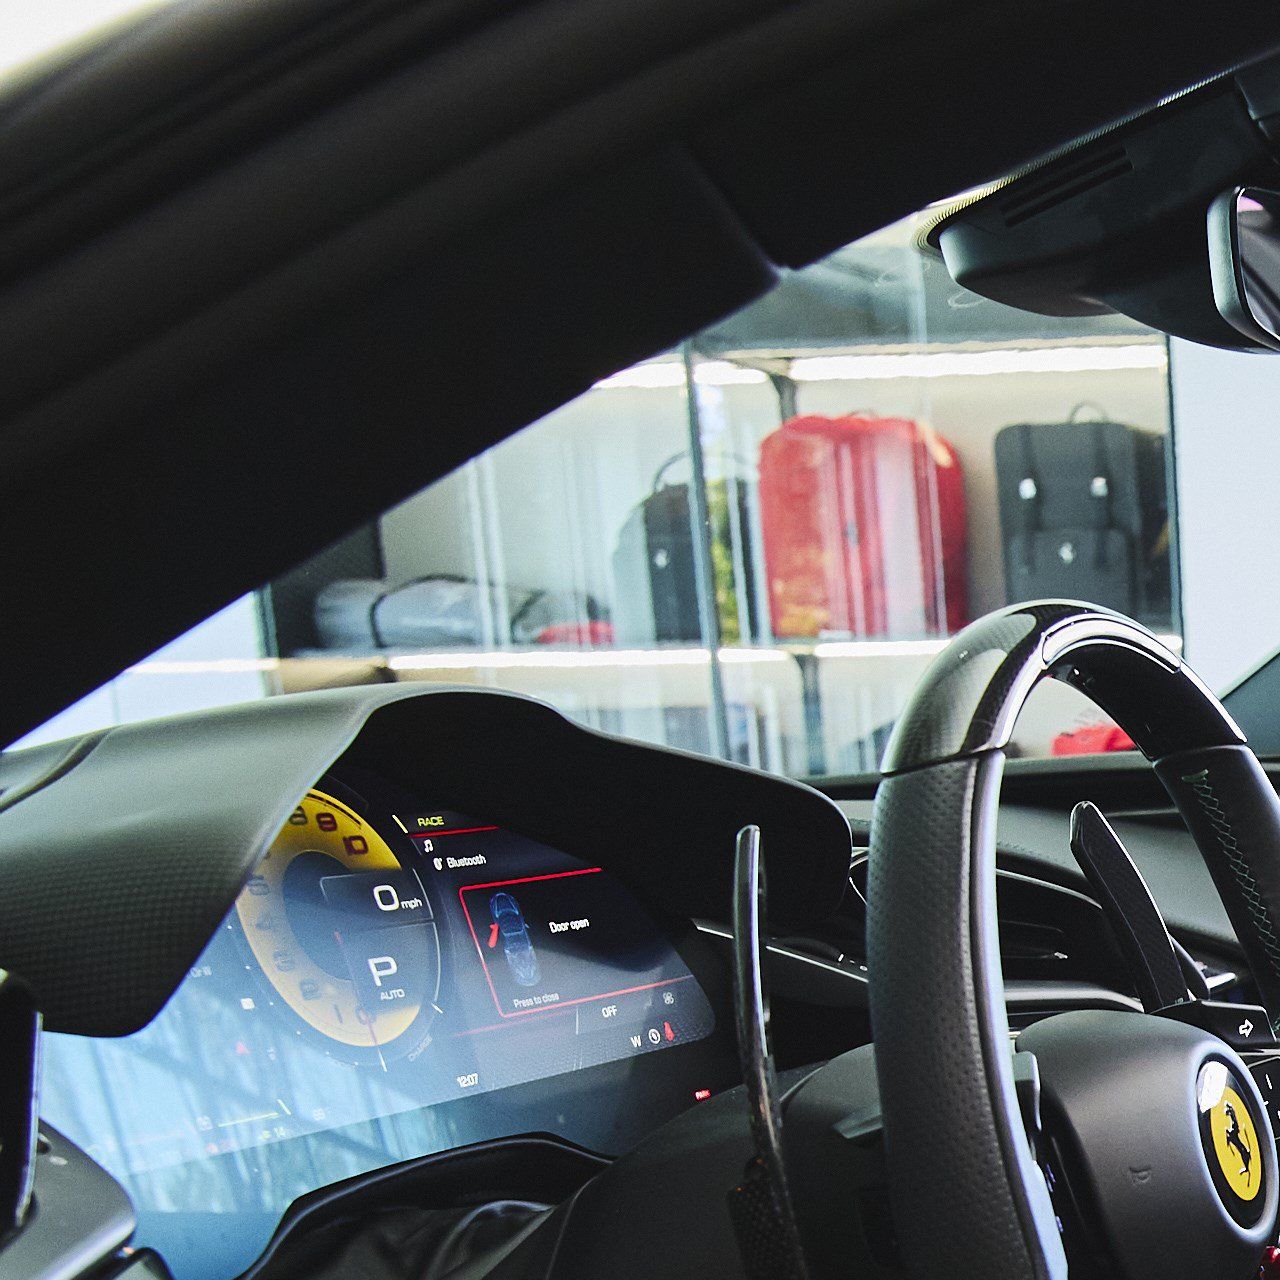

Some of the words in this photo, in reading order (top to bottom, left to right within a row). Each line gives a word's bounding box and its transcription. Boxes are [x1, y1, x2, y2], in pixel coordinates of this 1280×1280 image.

[316, 812, 338, 832] 9
[417, 816, 445, 827] RACE
[343, 835, 369, 856] 10
[447, 854, 487, 869] Bluetooth
[373, 885, 399, 911] 0
[401, 896, 423, 910] mph
[549, 920, 569, 933] Door
[569, 918, 590, 932] open
[368, 956, 397, 987] P
[380, 988, 406, 1001] AUTO
[513, 997, 533, 1009] Press
[533, 996, 542, 1004] to
[542, 993, 560, 1004] close
[601, 1004, 618, 1019] OFF
[630, 1034, 642, 1048] W
